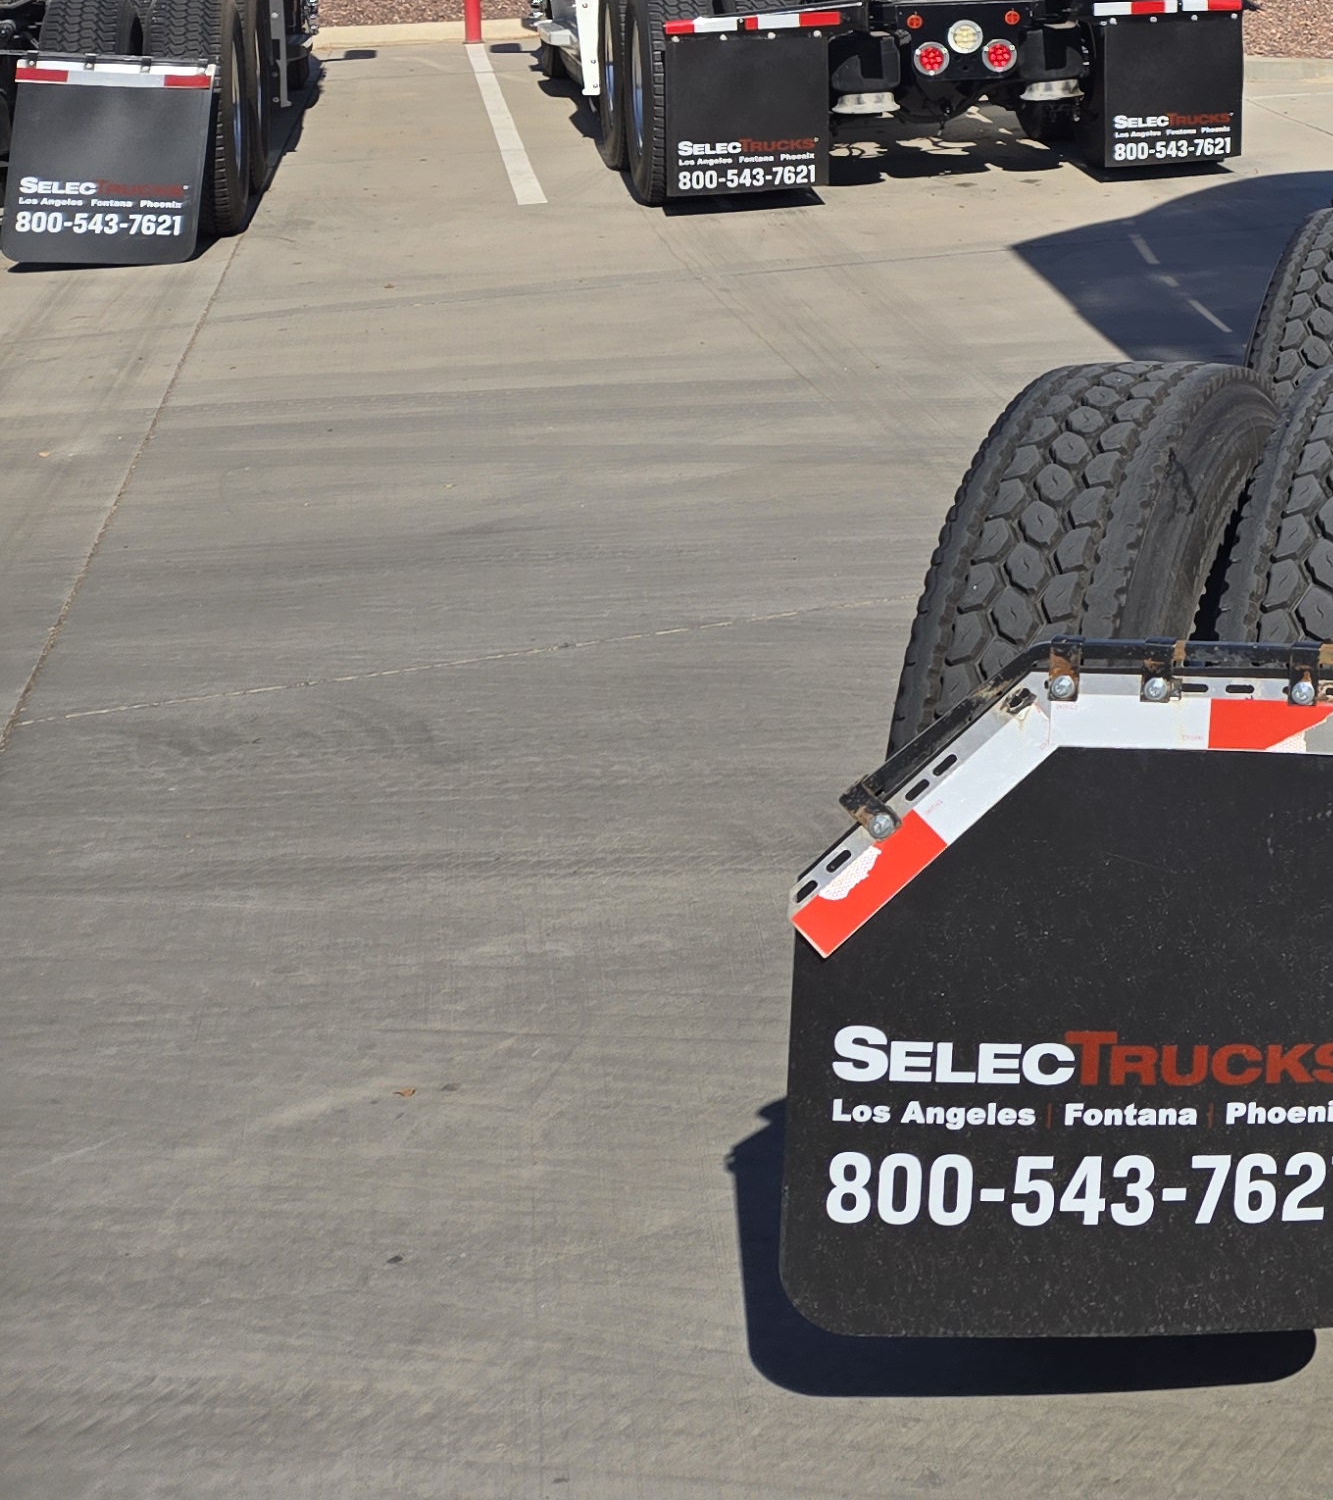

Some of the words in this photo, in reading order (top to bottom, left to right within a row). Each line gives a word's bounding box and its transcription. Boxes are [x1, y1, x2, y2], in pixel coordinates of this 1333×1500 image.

[1114, 137, 1231, 160] 800-543-7621
[678, 164, 816, 190] 800-543-7621
[18, 196, 38, 205] Los
[40, 197, 83, 207] Angeles
[91, 199, 133, 207] Fontana
[140, 200, 182, 209] Phoenix
[15, 211, 183, 236] 800-543-7621
[831, 1098, 892, 1123] Los
[900, 1100, 1037, 1130] Angeles
[1063, 1102, 1198, 1128] Fontana
